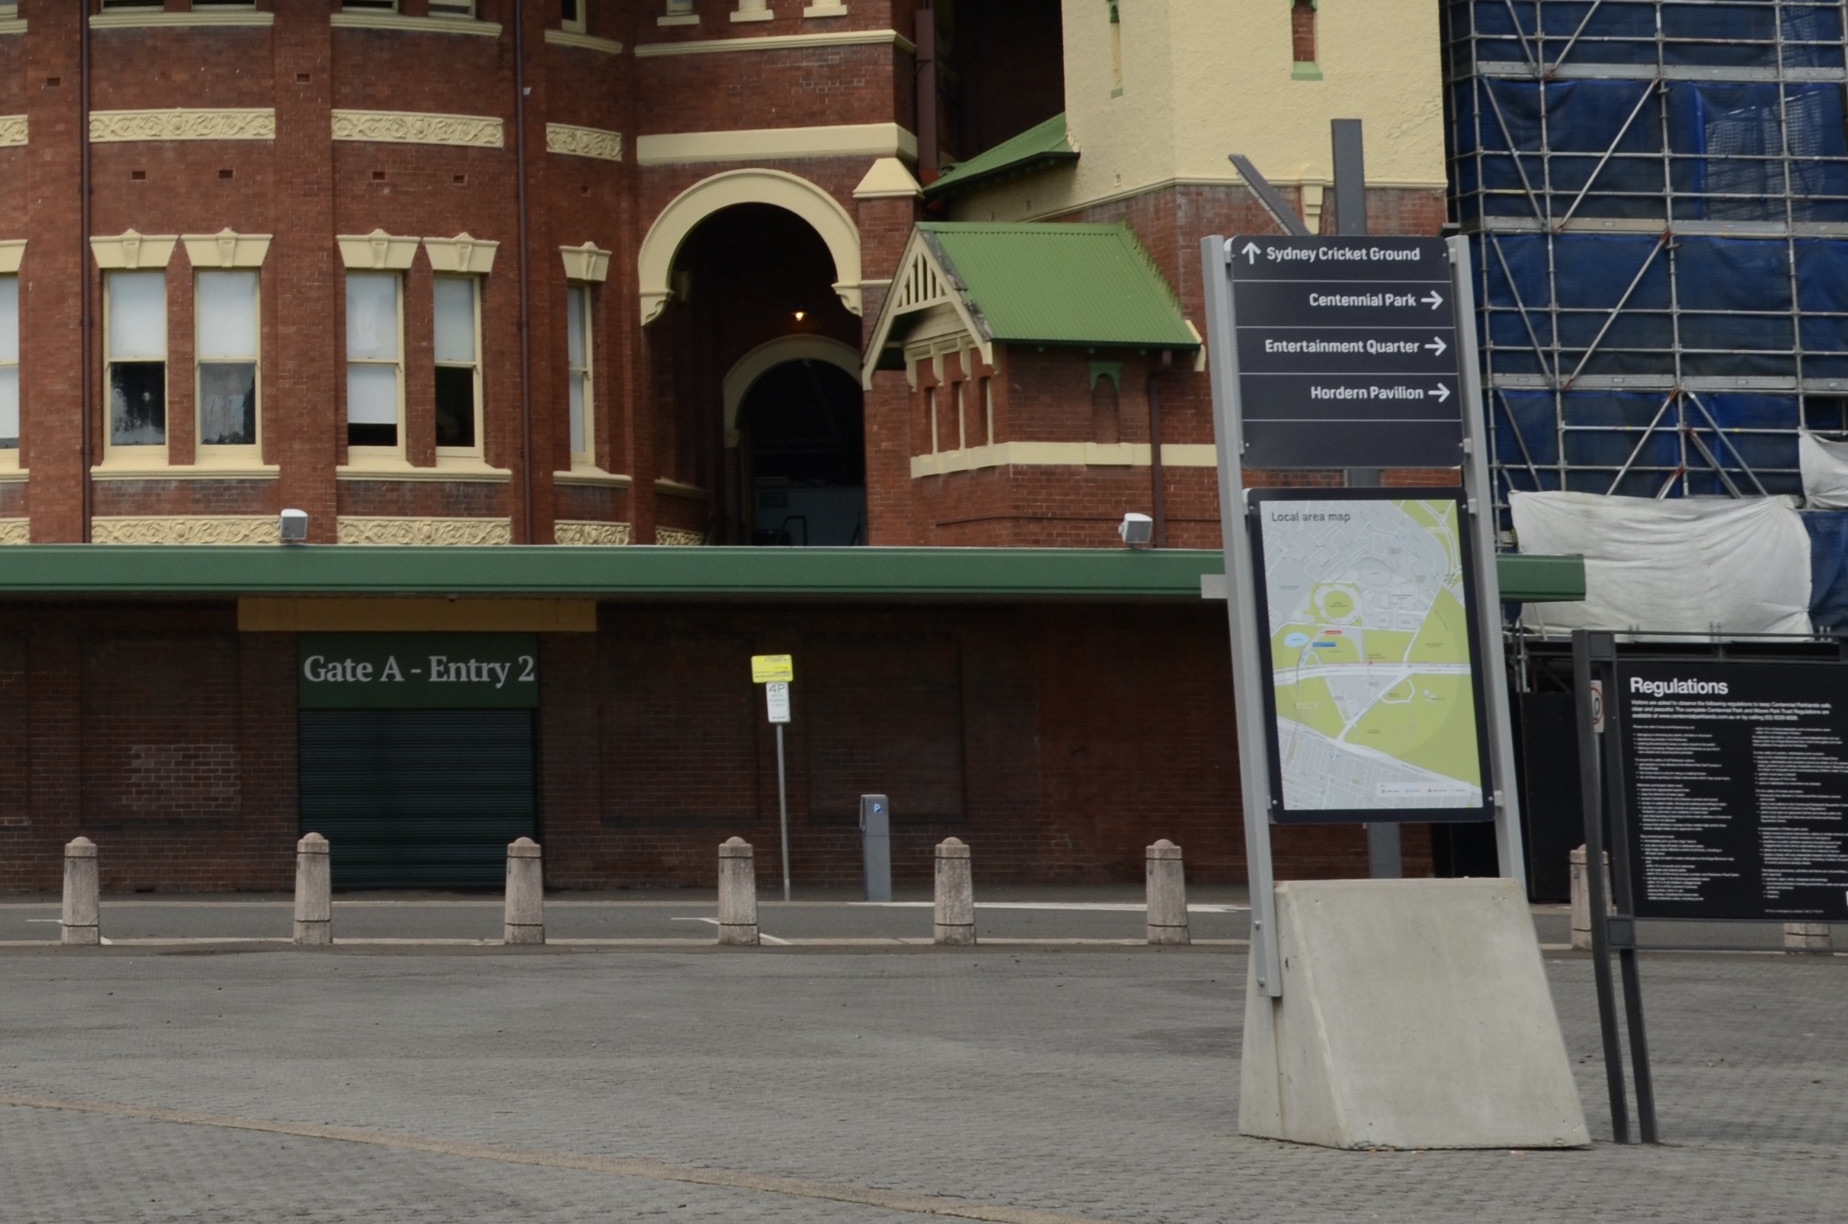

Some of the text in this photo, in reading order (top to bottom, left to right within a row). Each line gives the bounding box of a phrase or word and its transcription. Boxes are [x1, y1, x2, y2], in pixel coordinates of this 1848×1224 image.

[1266, 246, 1420, 264] Sydney Cricket Ground
[1309, 293, 1416, 307] Centennial Park
[1265, 339, 1420, 355] Entertainment Quarter
[1311, 386, 1424, 400] Hordern Pavilion
[1271, 512, 1351, 524] Local area map
[303, 655, 373, 682] Gate
[379, 655, 404, 682] A
[428, 655, 512, 689] Entry
[517, 655, 535, 681] 2
[768, 683, 785, 694] 4P
[1630, 676, 1729, 697] Regulations
[873, 803, 881, 813] P
